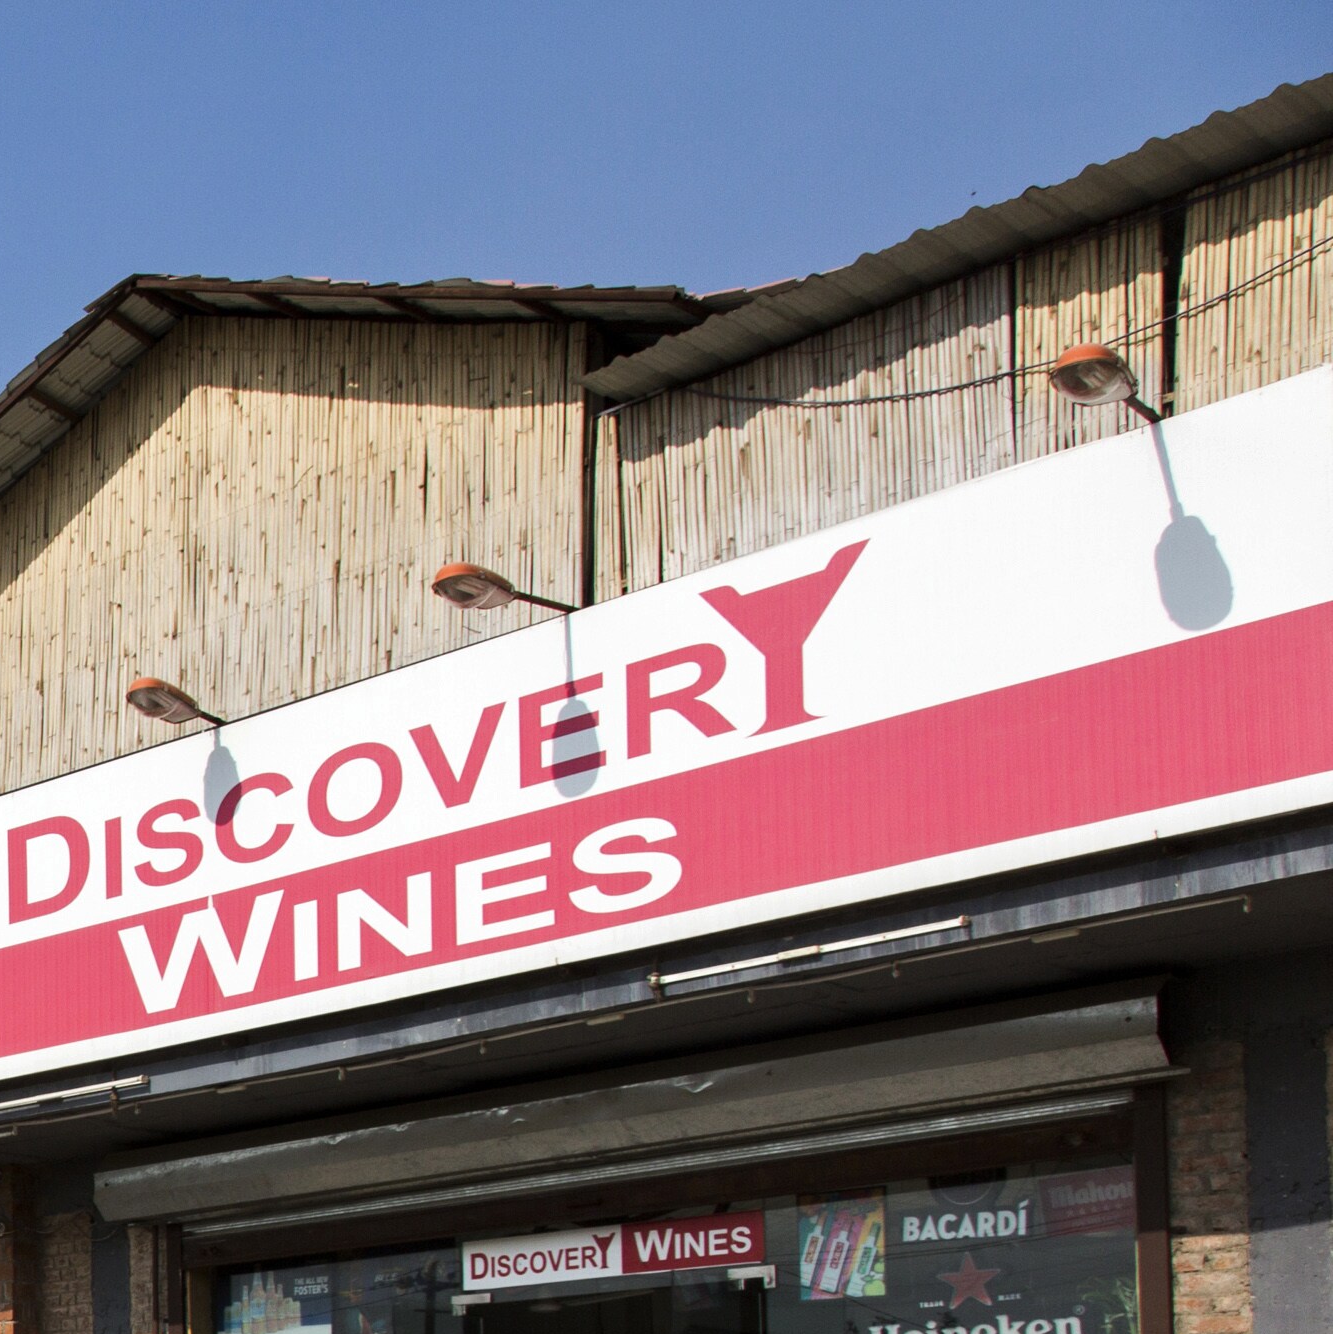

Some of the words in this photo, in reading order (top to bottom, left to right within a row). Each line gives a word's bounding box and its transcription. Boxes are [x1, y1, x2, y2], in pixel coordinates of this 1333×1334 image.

[5, 538, 870, 924] DISCOVERY
[117, 816, 683, 1014] WINES
[470, 1231, 616, 1280] DISCOVERY
[633, 1226, 752, 1263] WINES
